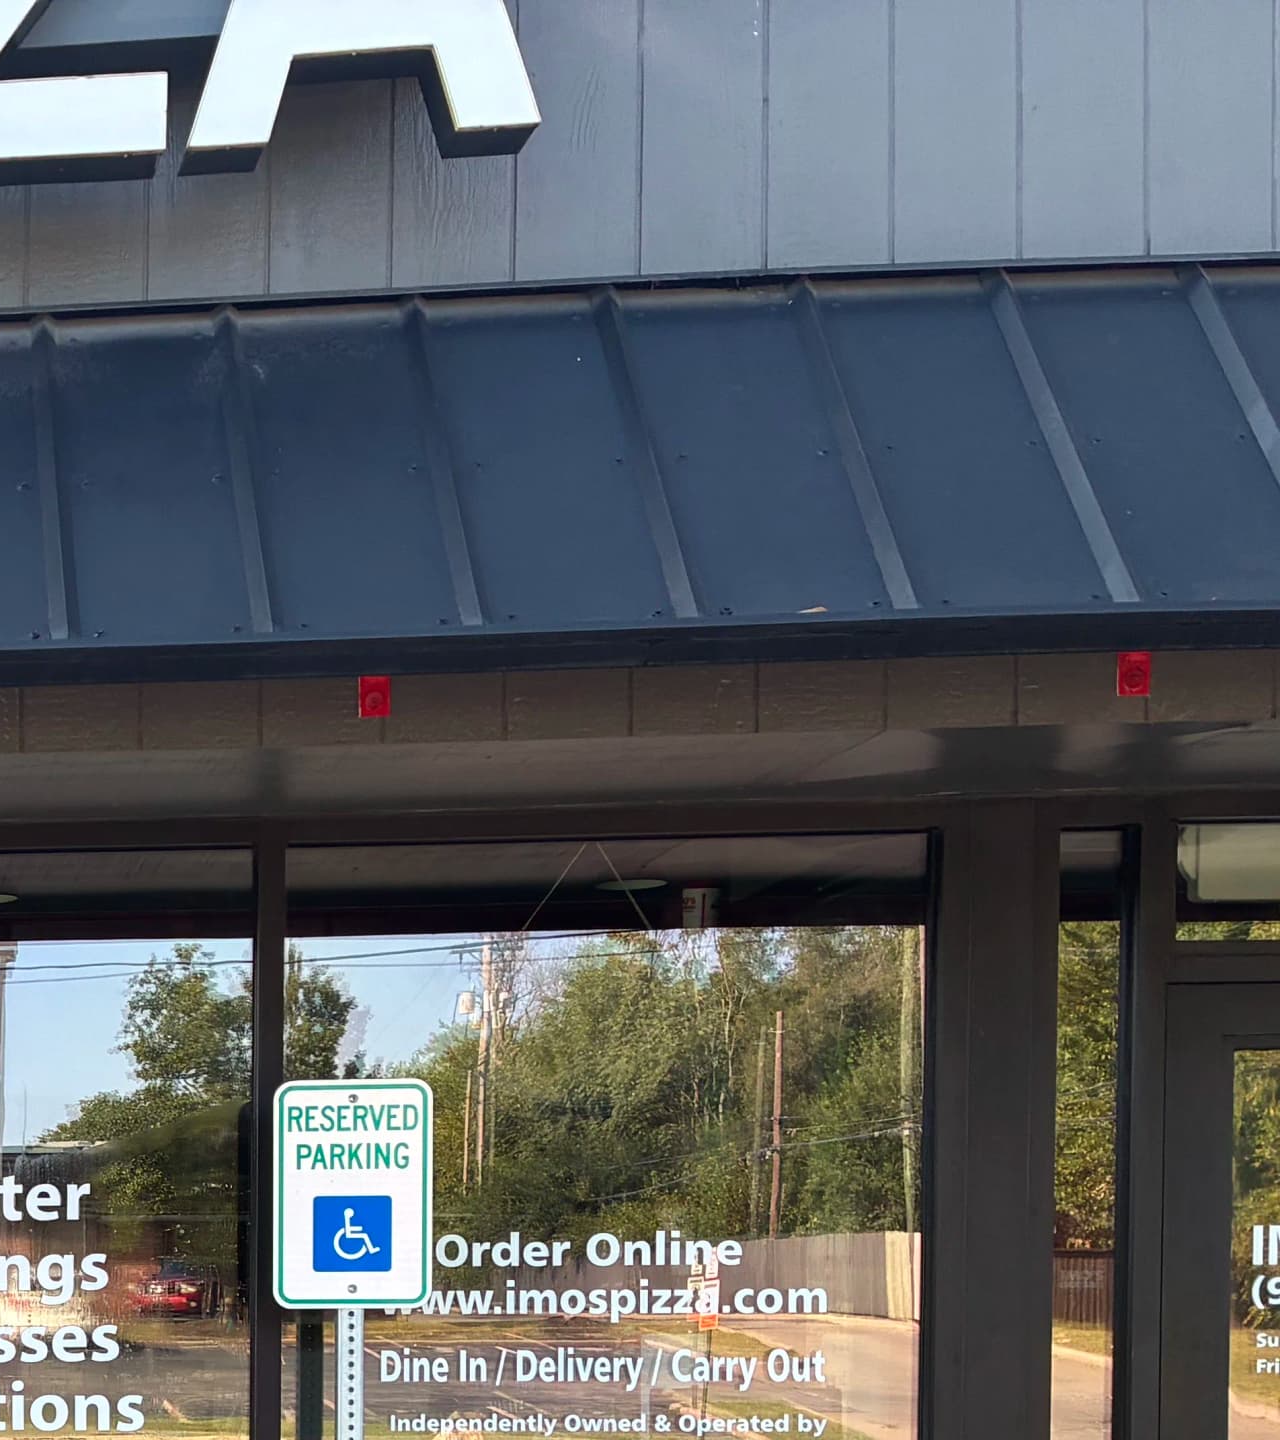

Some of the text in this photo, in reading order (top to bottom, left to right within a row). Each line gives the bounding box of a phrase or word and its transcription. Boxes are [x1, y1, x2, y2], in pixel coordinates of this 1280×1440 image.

[287, 1104, 419, 1132] RESERVED
[296, 1142, 410, 1169] PARKING
[436, 1231, 743, 1267] Order Online
[383, 1280, 829, 1323] ww.imospizza.com
[380, 1349, 449, 1383] Dine
[459, 1350, 487, 1383] In
[516, 1347, 644, 1391] Delivery
[671, 1348, 757, 1391] Carry
[767, 1348, 826, 1383] Out
[389, 1413, 828, 1436] Independently Owned & Operated by
